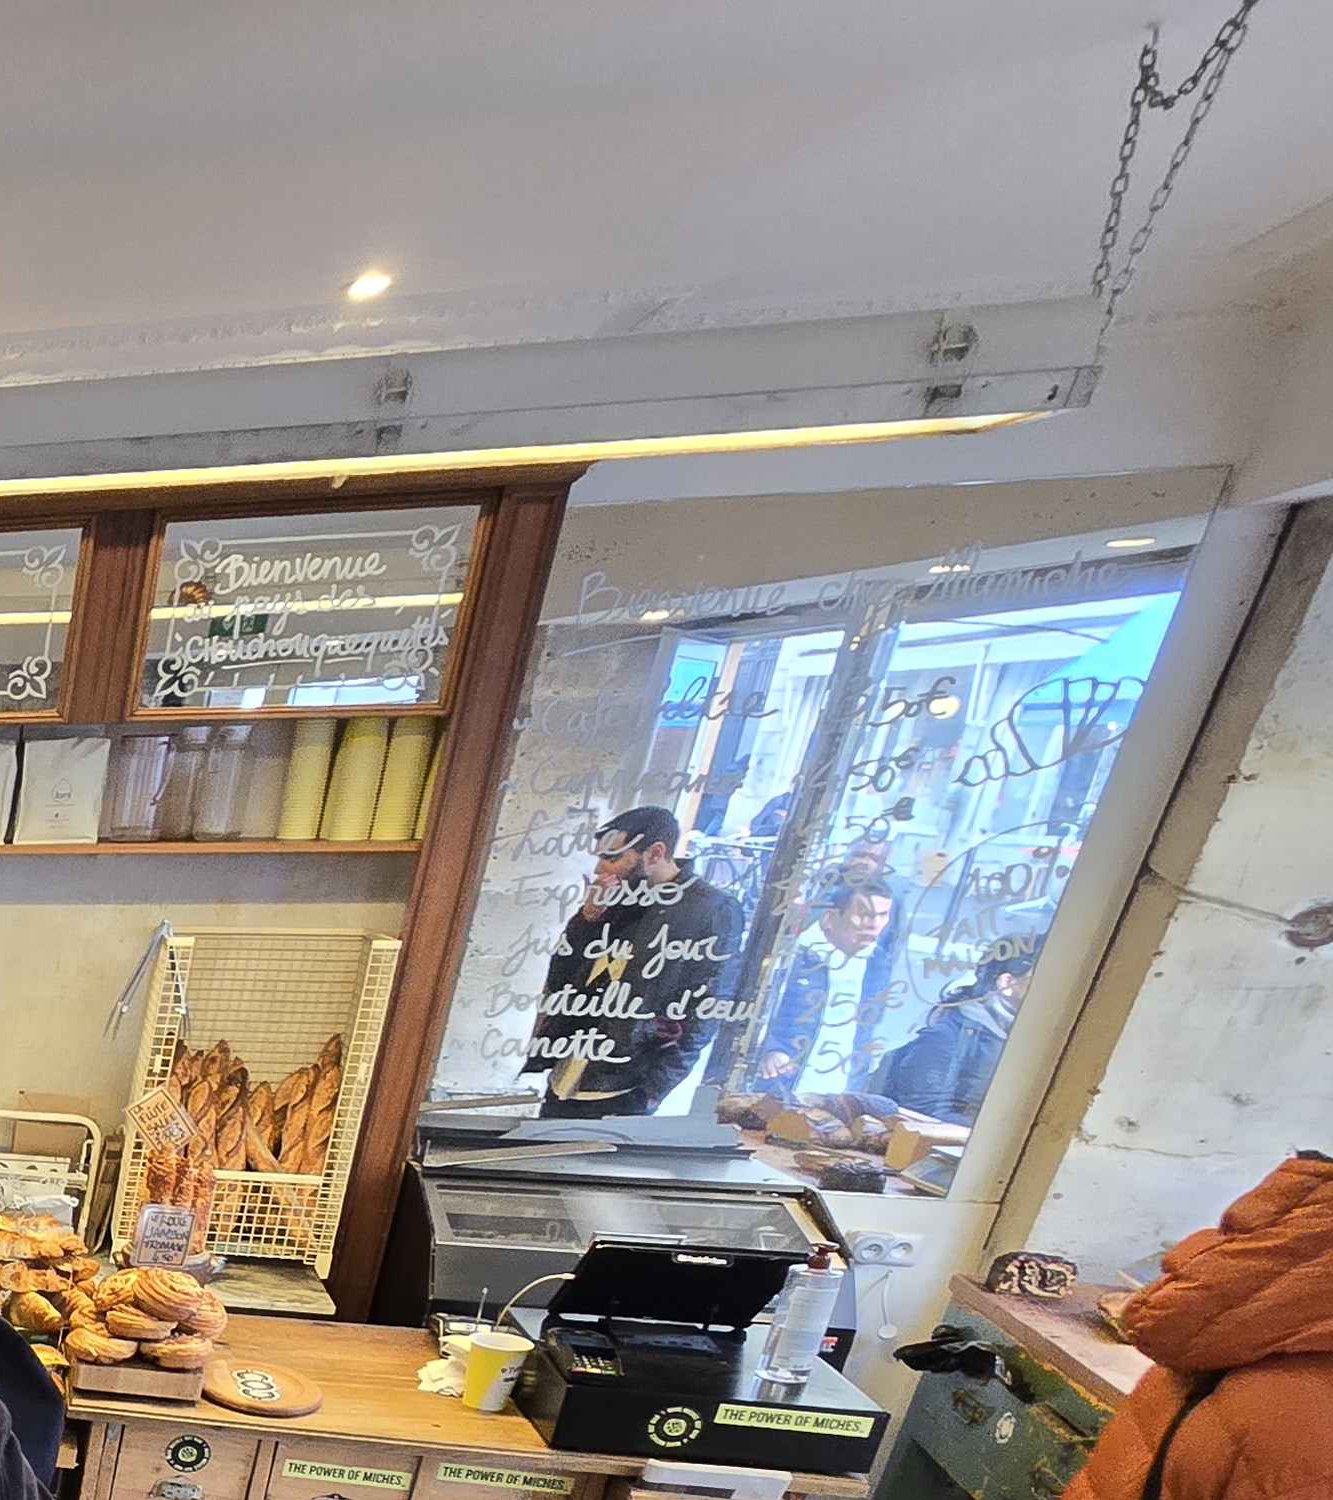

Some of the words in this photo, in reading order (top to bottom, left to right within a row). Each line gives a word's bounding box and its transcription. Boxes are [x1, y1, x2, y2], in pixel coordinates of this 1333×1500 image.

[213, 552, 387, 595] Bienvenue
[516, 871, 700, 922] Expresso
[484, 981, 655, 1020] Bouteille
[480, 1028, 631, 1065] Canette
[722, 1409, 744, 1421] THE
[749, 1412, 792, 1425] POWER
[795, 1416, 811, 1427] OF
[288, 1462, 307, 1474] THE
[309, 1466, 345, 1479] POWER
[347, 1470, 361, 1480] OF
[443, 1466, 464, 1479] THE
[466, 1469, 504, 1483] POWER
[506, 1474, 520, 1485] OF
